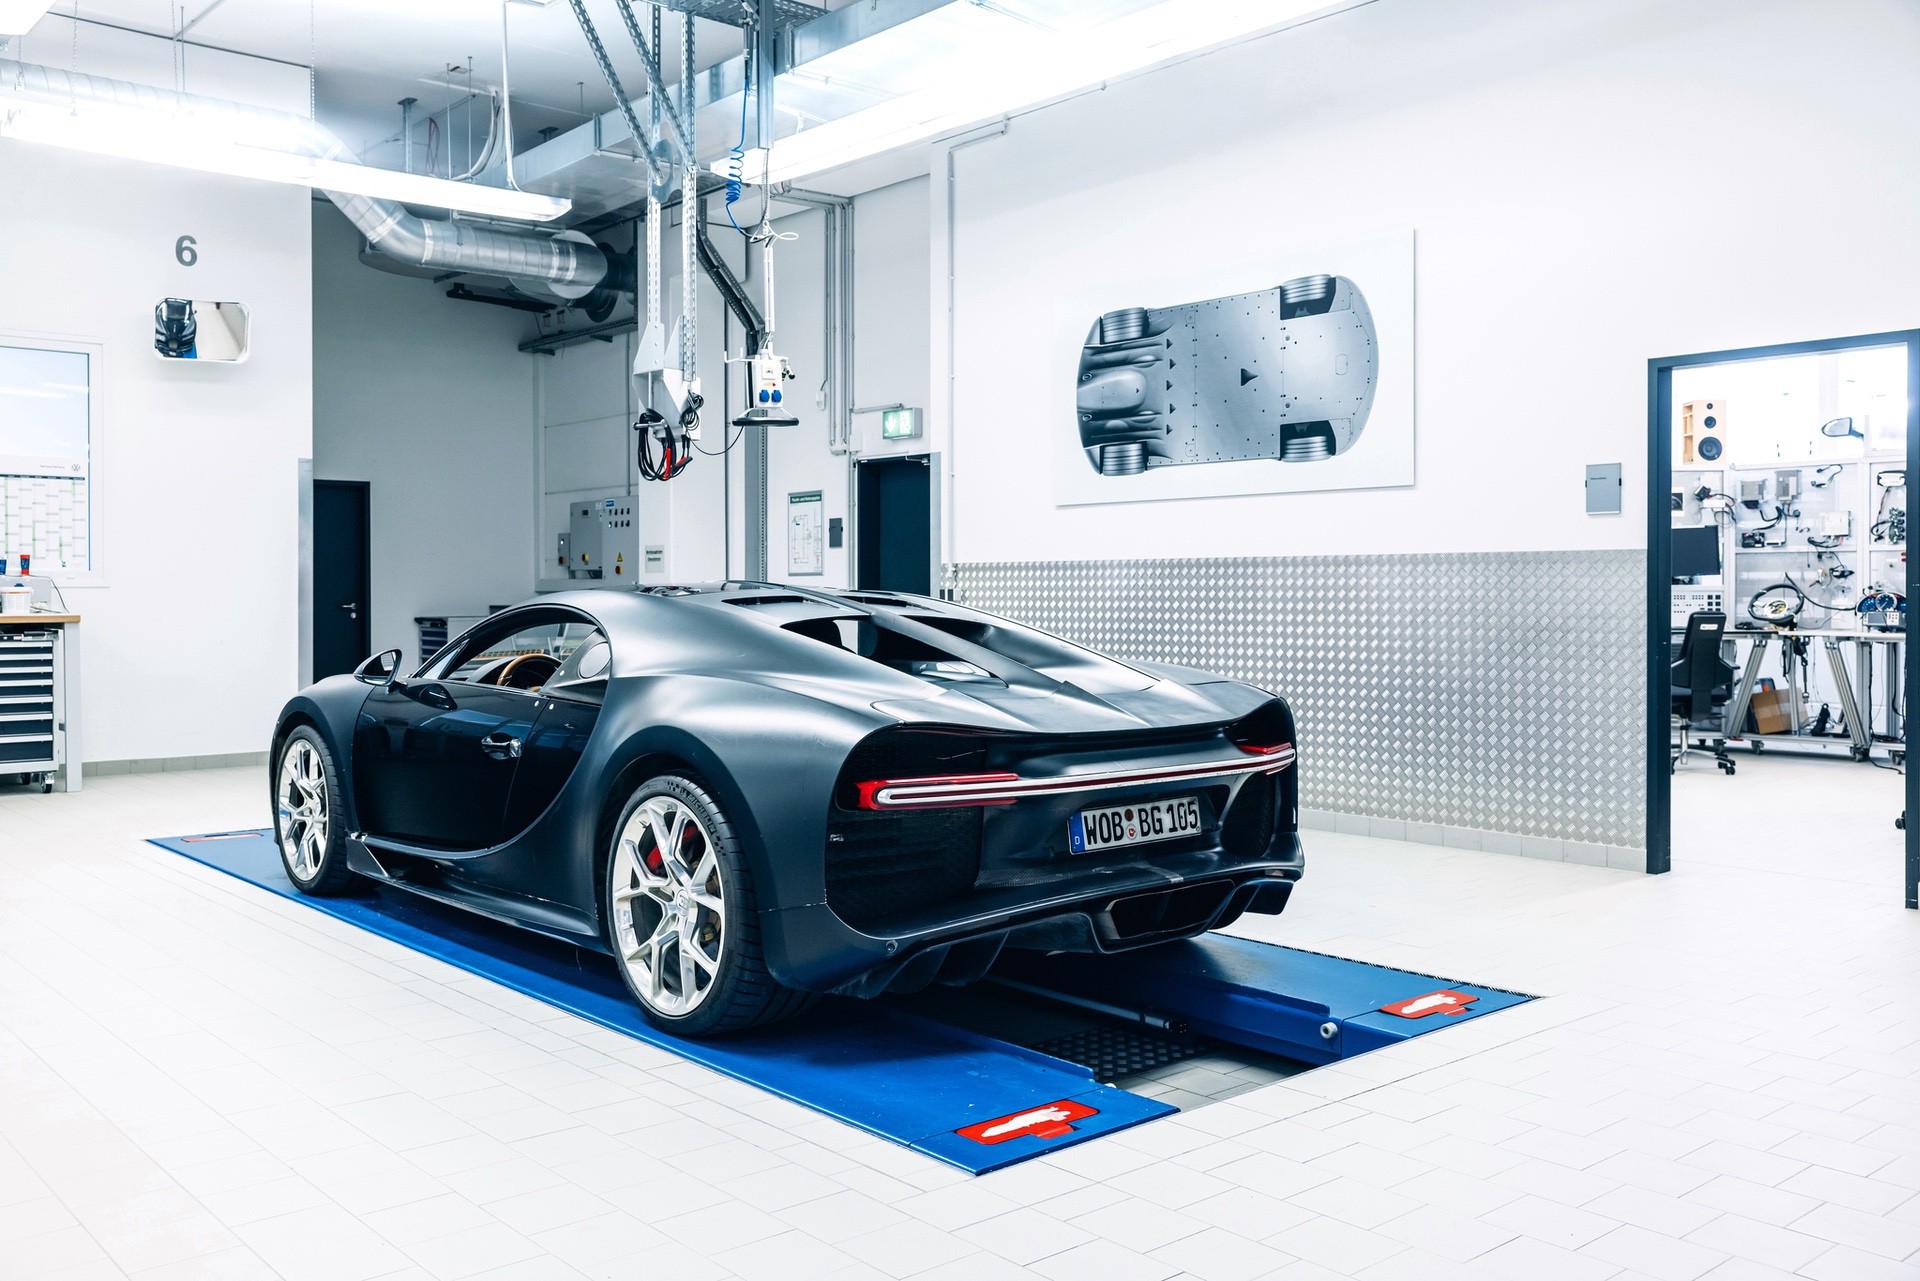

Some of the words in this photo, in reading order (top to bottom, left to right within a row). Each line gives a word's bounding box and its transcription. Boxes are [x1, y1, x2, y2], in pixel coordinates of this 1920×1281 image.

[175, 234, 198, 267] 6
[686, 791, 717, 835] MICHELIN
[1084, 811, 1124, 846] WOB
[1138, 805, 1163, 837] BG
[1166, 801, 1198, 833] 105
